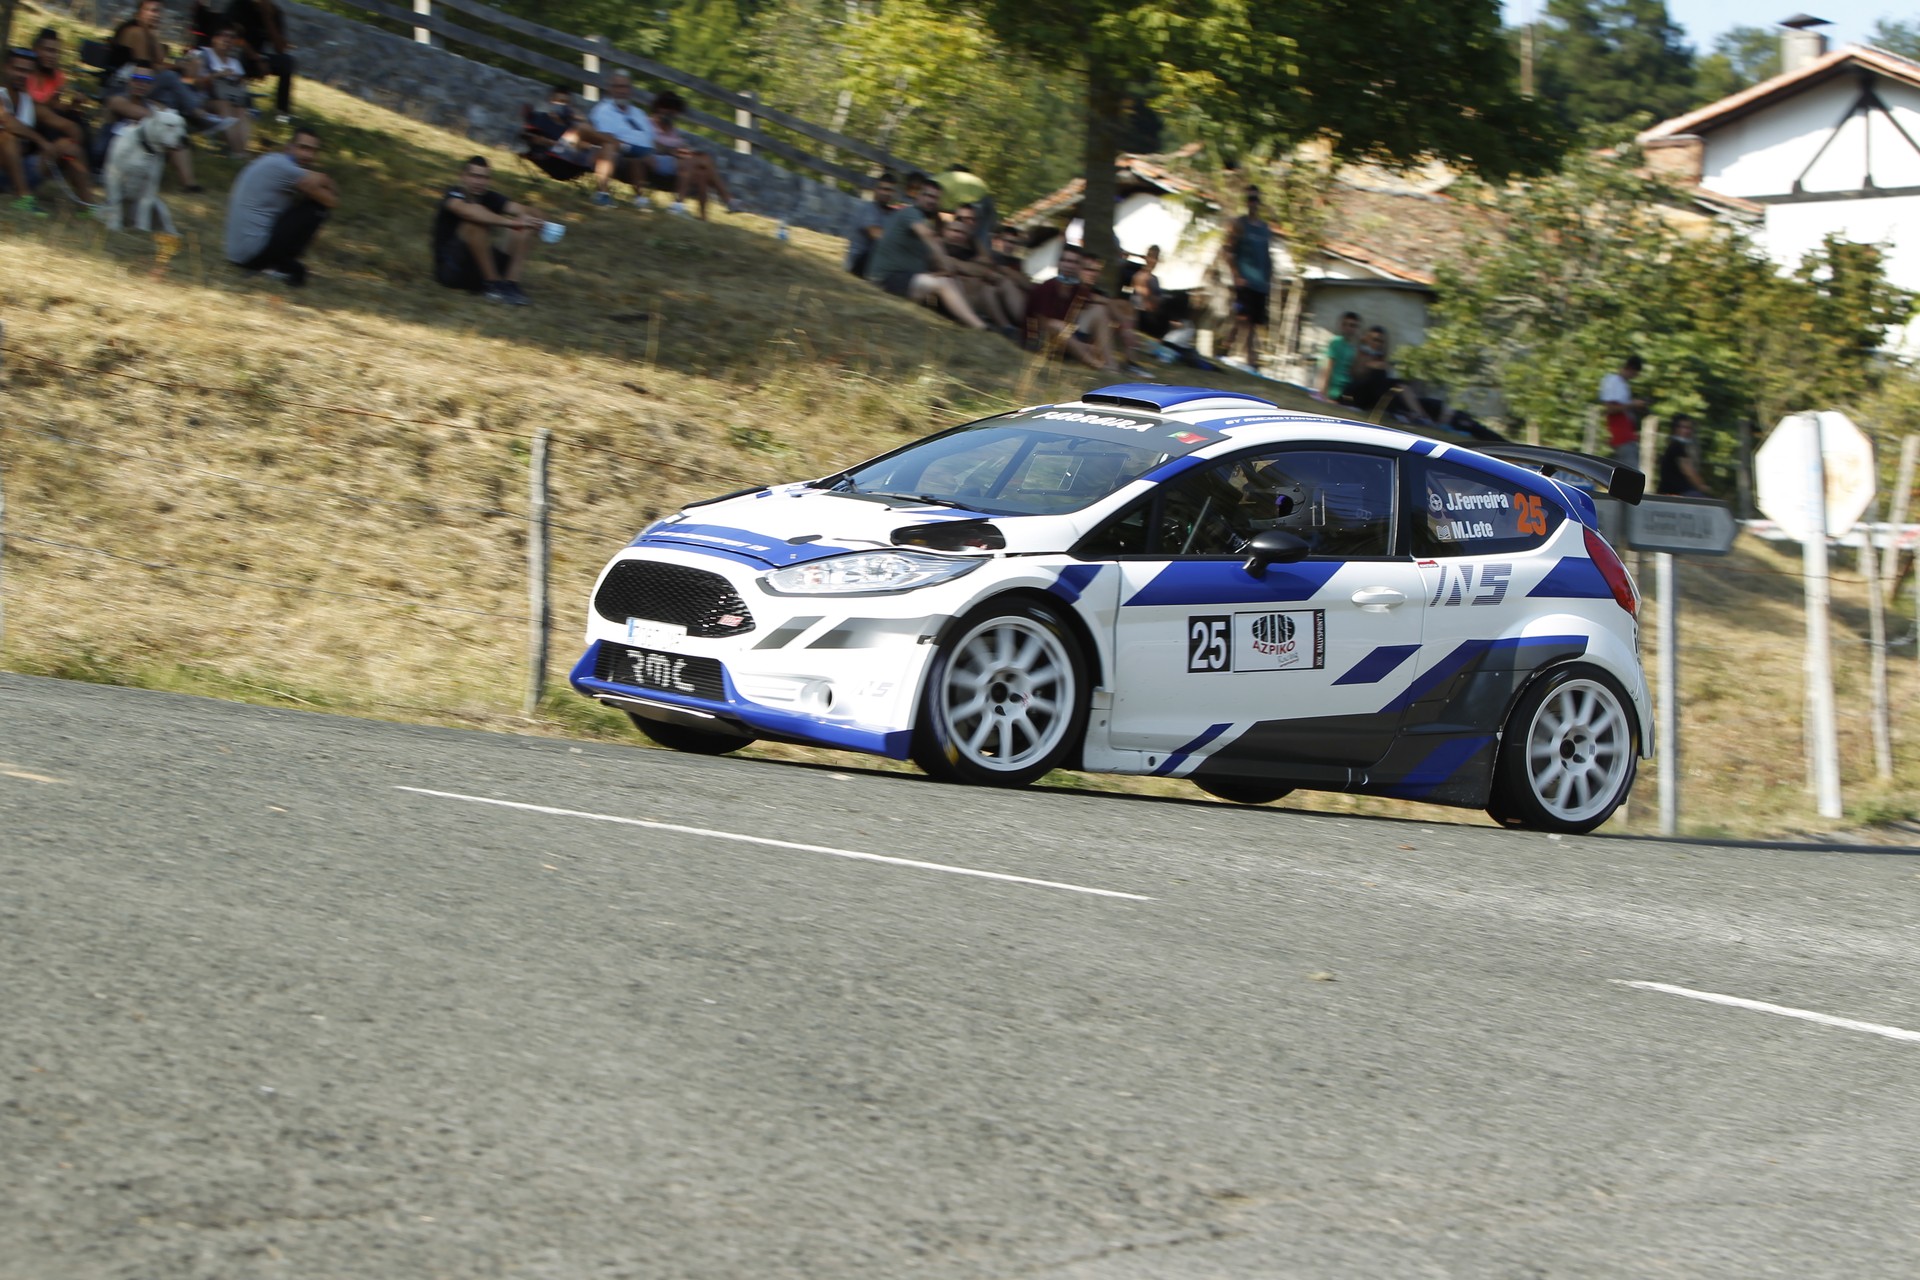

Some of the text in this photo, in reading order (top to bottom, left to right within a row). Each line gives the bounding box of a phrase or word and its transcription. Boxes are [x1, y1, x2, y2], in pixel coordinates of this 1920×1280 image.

[1446, 492, 1509, 511] J.Ferreira
[1513, 492, 1547, 536] 25
[1451, 521, 1494, 539] M.Lete
[1190, 621, 1228, 670] 25
[1252, 640, 1296, 655] AZPIKO
